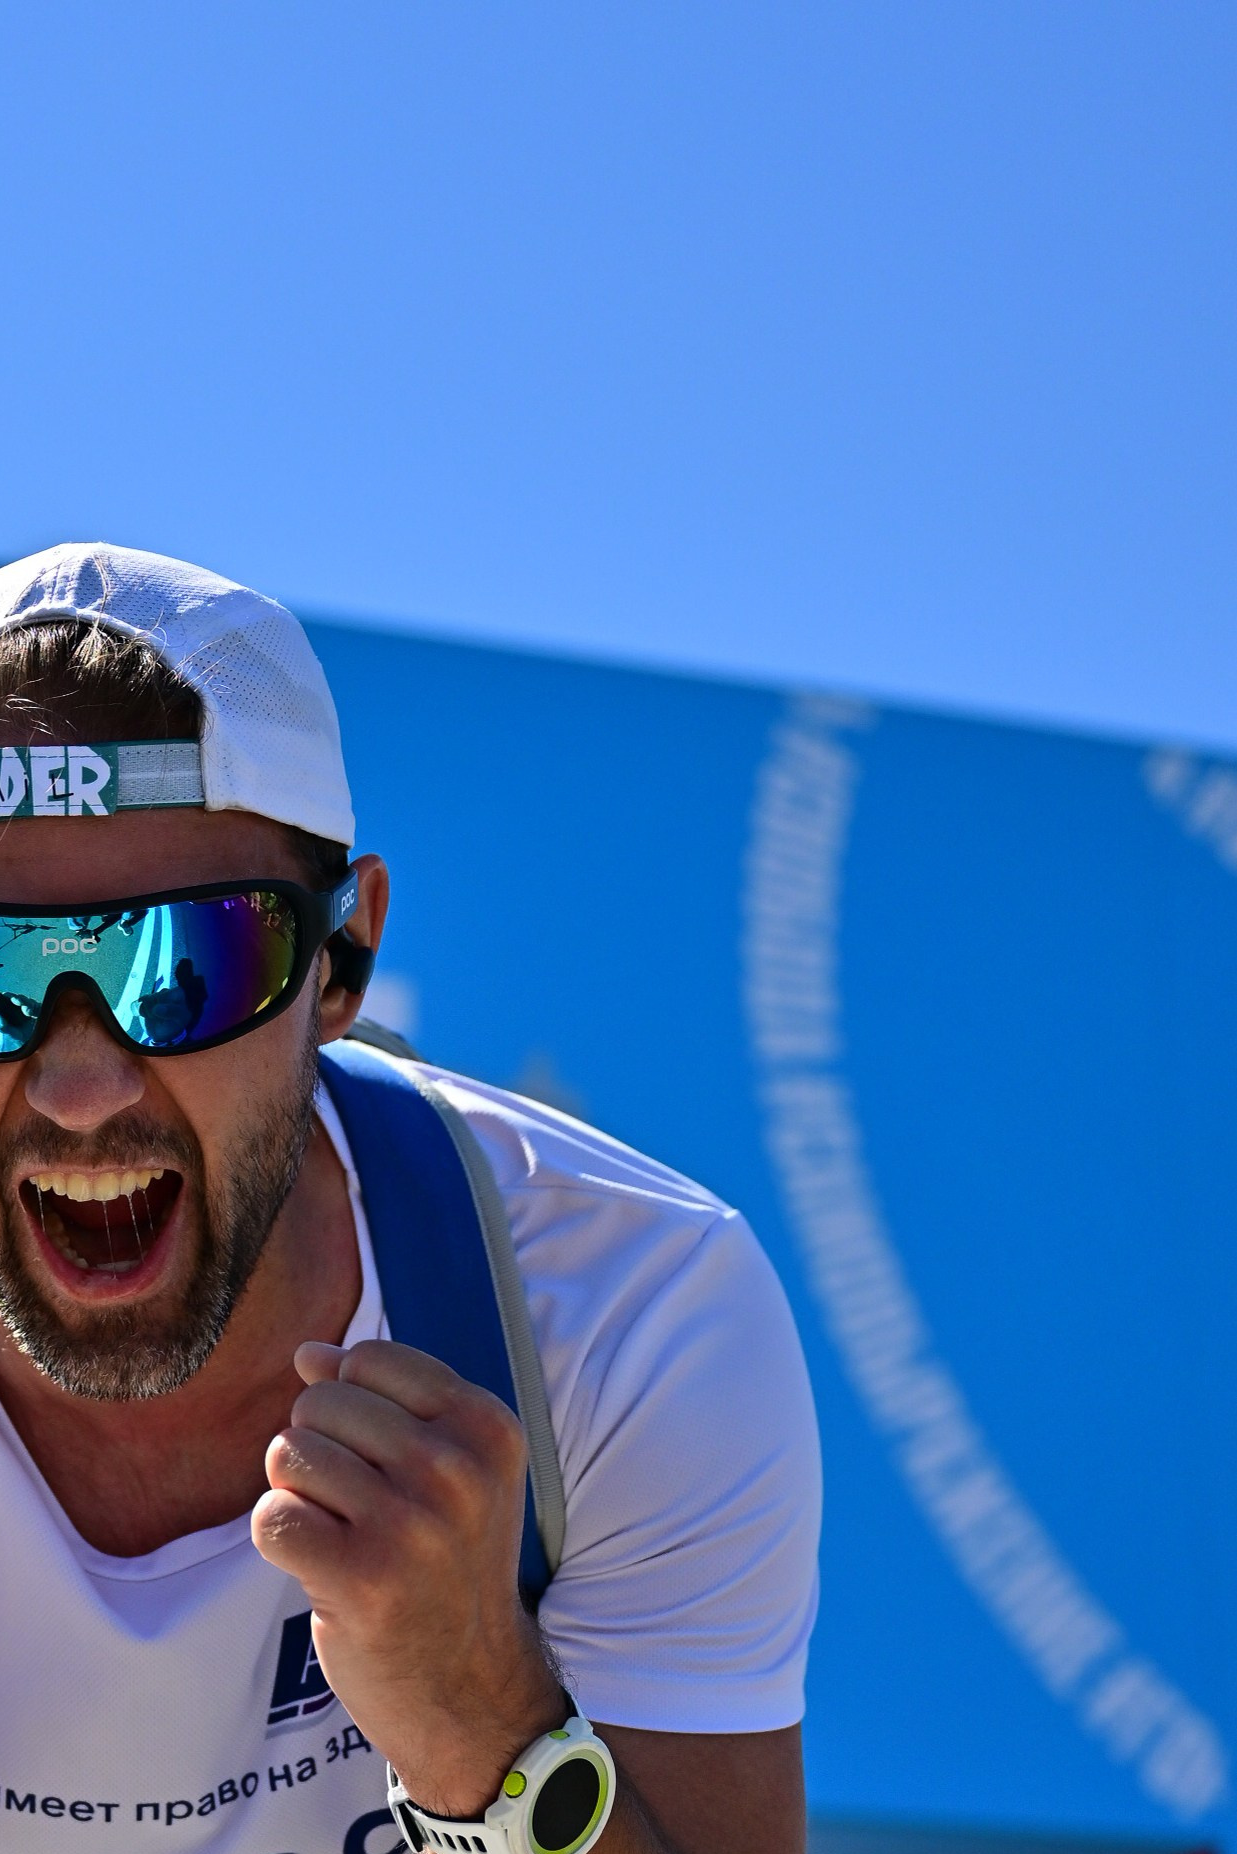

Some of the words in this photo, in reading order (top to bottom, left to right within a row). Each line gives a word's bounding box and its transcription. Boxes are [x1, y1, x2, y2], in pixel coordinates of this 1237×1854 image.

[340, 888, 358, 917] poc
[41, 934, 99, 957] poc
[135, 1771, 260, 1826] право
[268, 1756, 317, 1792] на
[325, 1724, 372, 1764] зд
